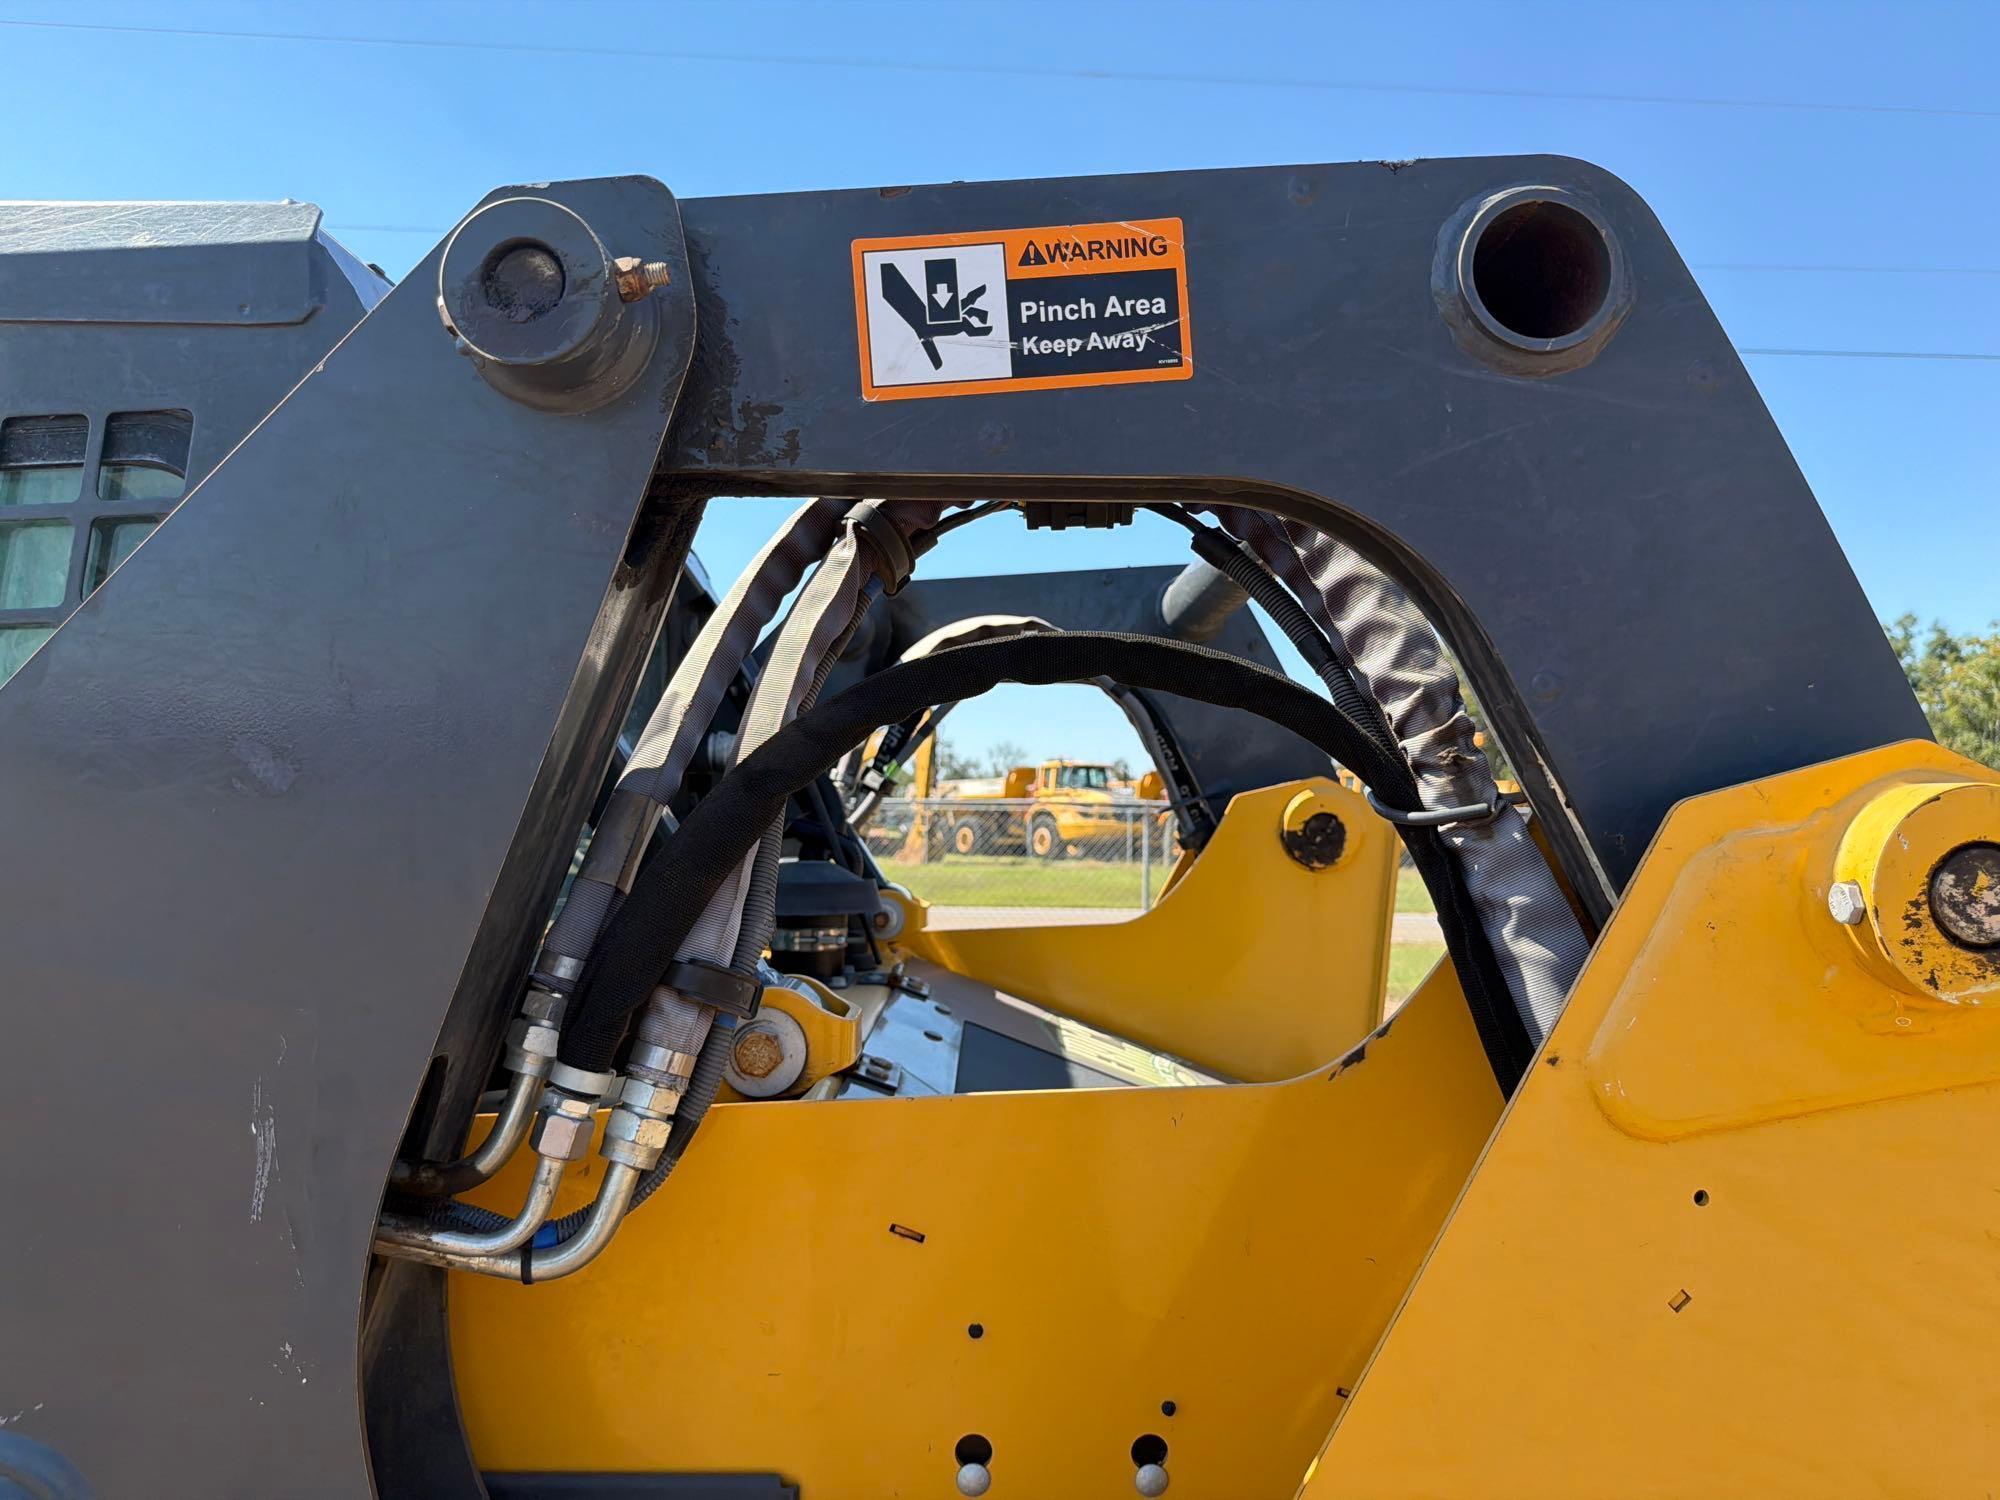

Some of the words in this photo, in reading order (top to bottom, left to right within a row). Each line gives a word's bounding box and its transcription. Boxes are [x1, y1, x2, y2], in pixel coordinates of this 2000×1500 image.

[1045, 236, 1168, 263] WARNING
[1020, 298, 1096, 324] Pinch
[1104, 295, 1167, 318] Area
[1022, 336, 1082, 357] Keep
[1086, 332, 1148, 352] Away
